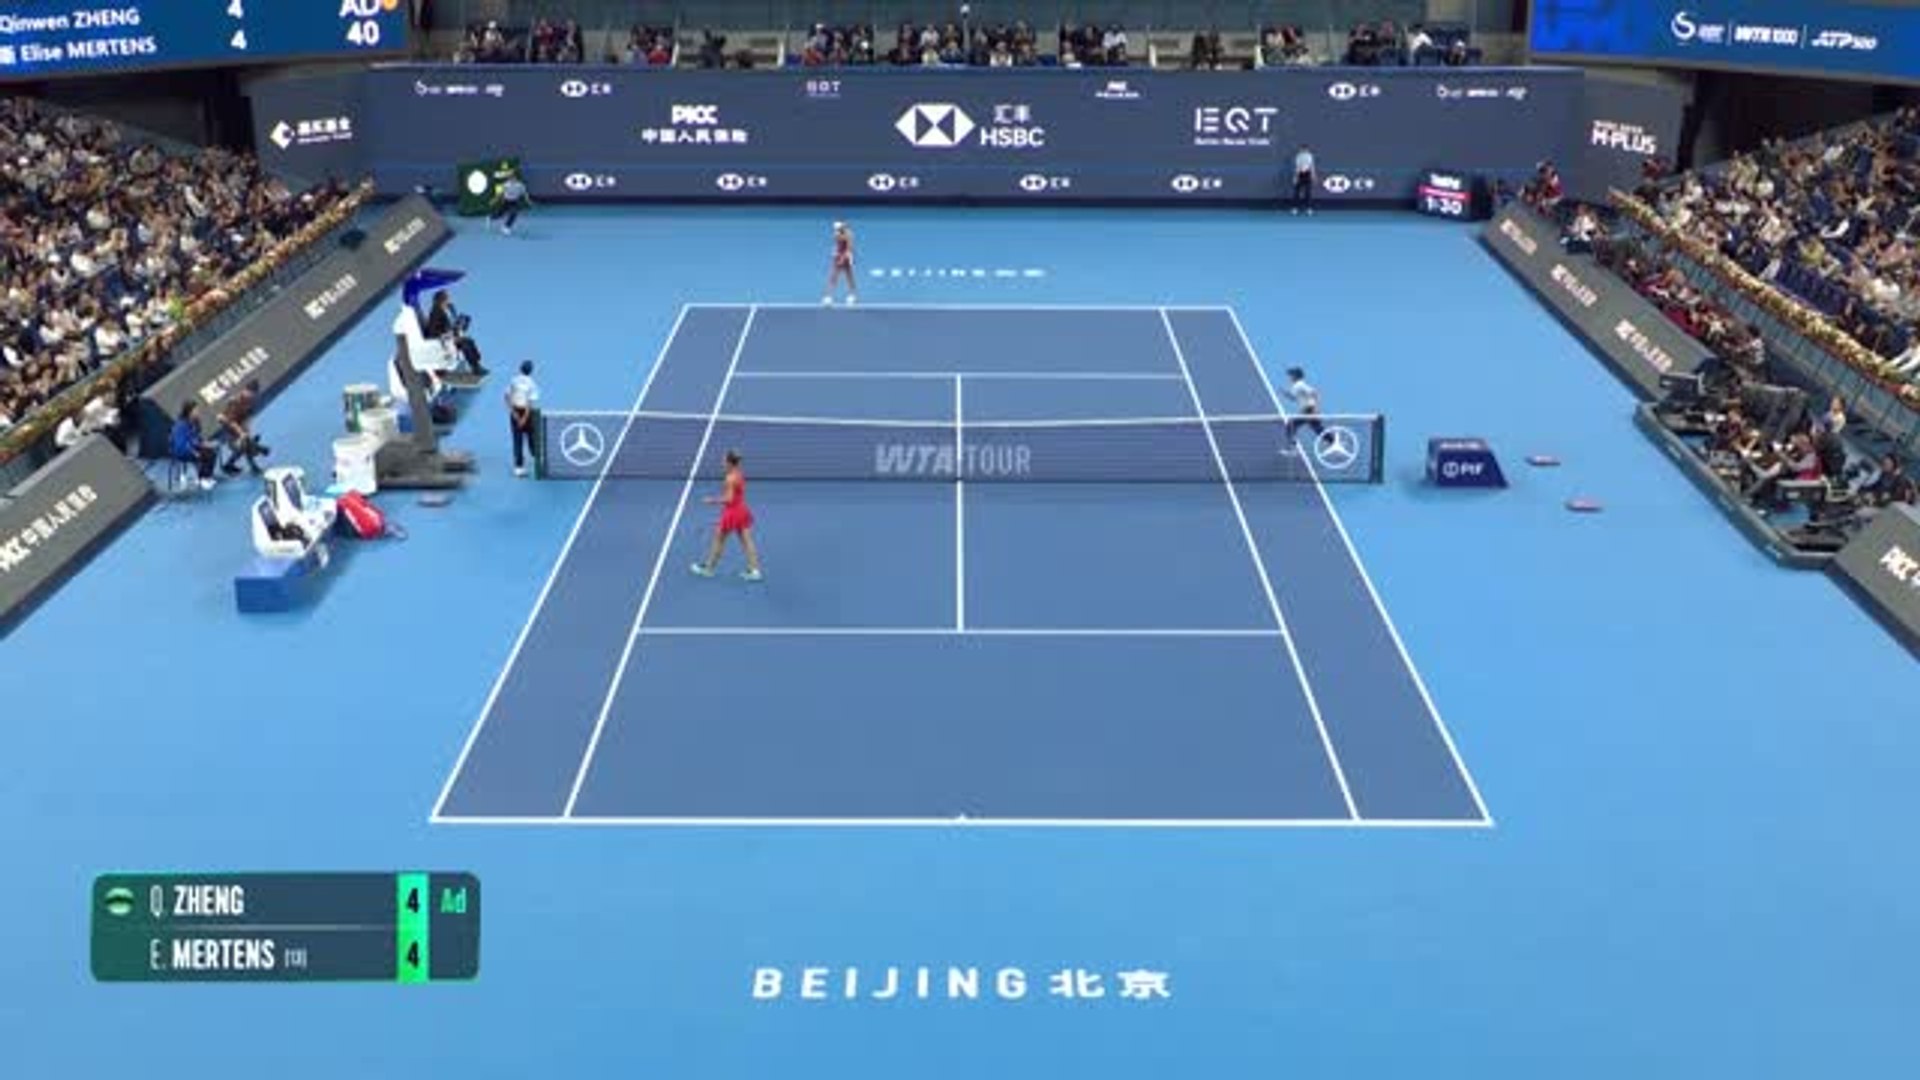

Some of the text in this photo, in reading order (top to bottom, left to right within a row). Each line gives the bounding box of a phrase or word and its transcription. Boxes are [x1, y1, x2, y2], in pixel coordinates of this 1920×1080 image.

[73, 8, 140, 28] ZHENG
[227, 0, 243, 18] 4
[20, 44, 62, 61] Elise
[66, 36, 156, 58] MERTENS
[230, 30, 247, 49] 4
[347, 20, 379, 45] 40
[1195, 107, 1278, 132] EQT
[980, 127, 1045, 147] HSBC
[966, 444, 1032, 475] TOUR
[752, 967, 1172, 999] BEIJING 北京
